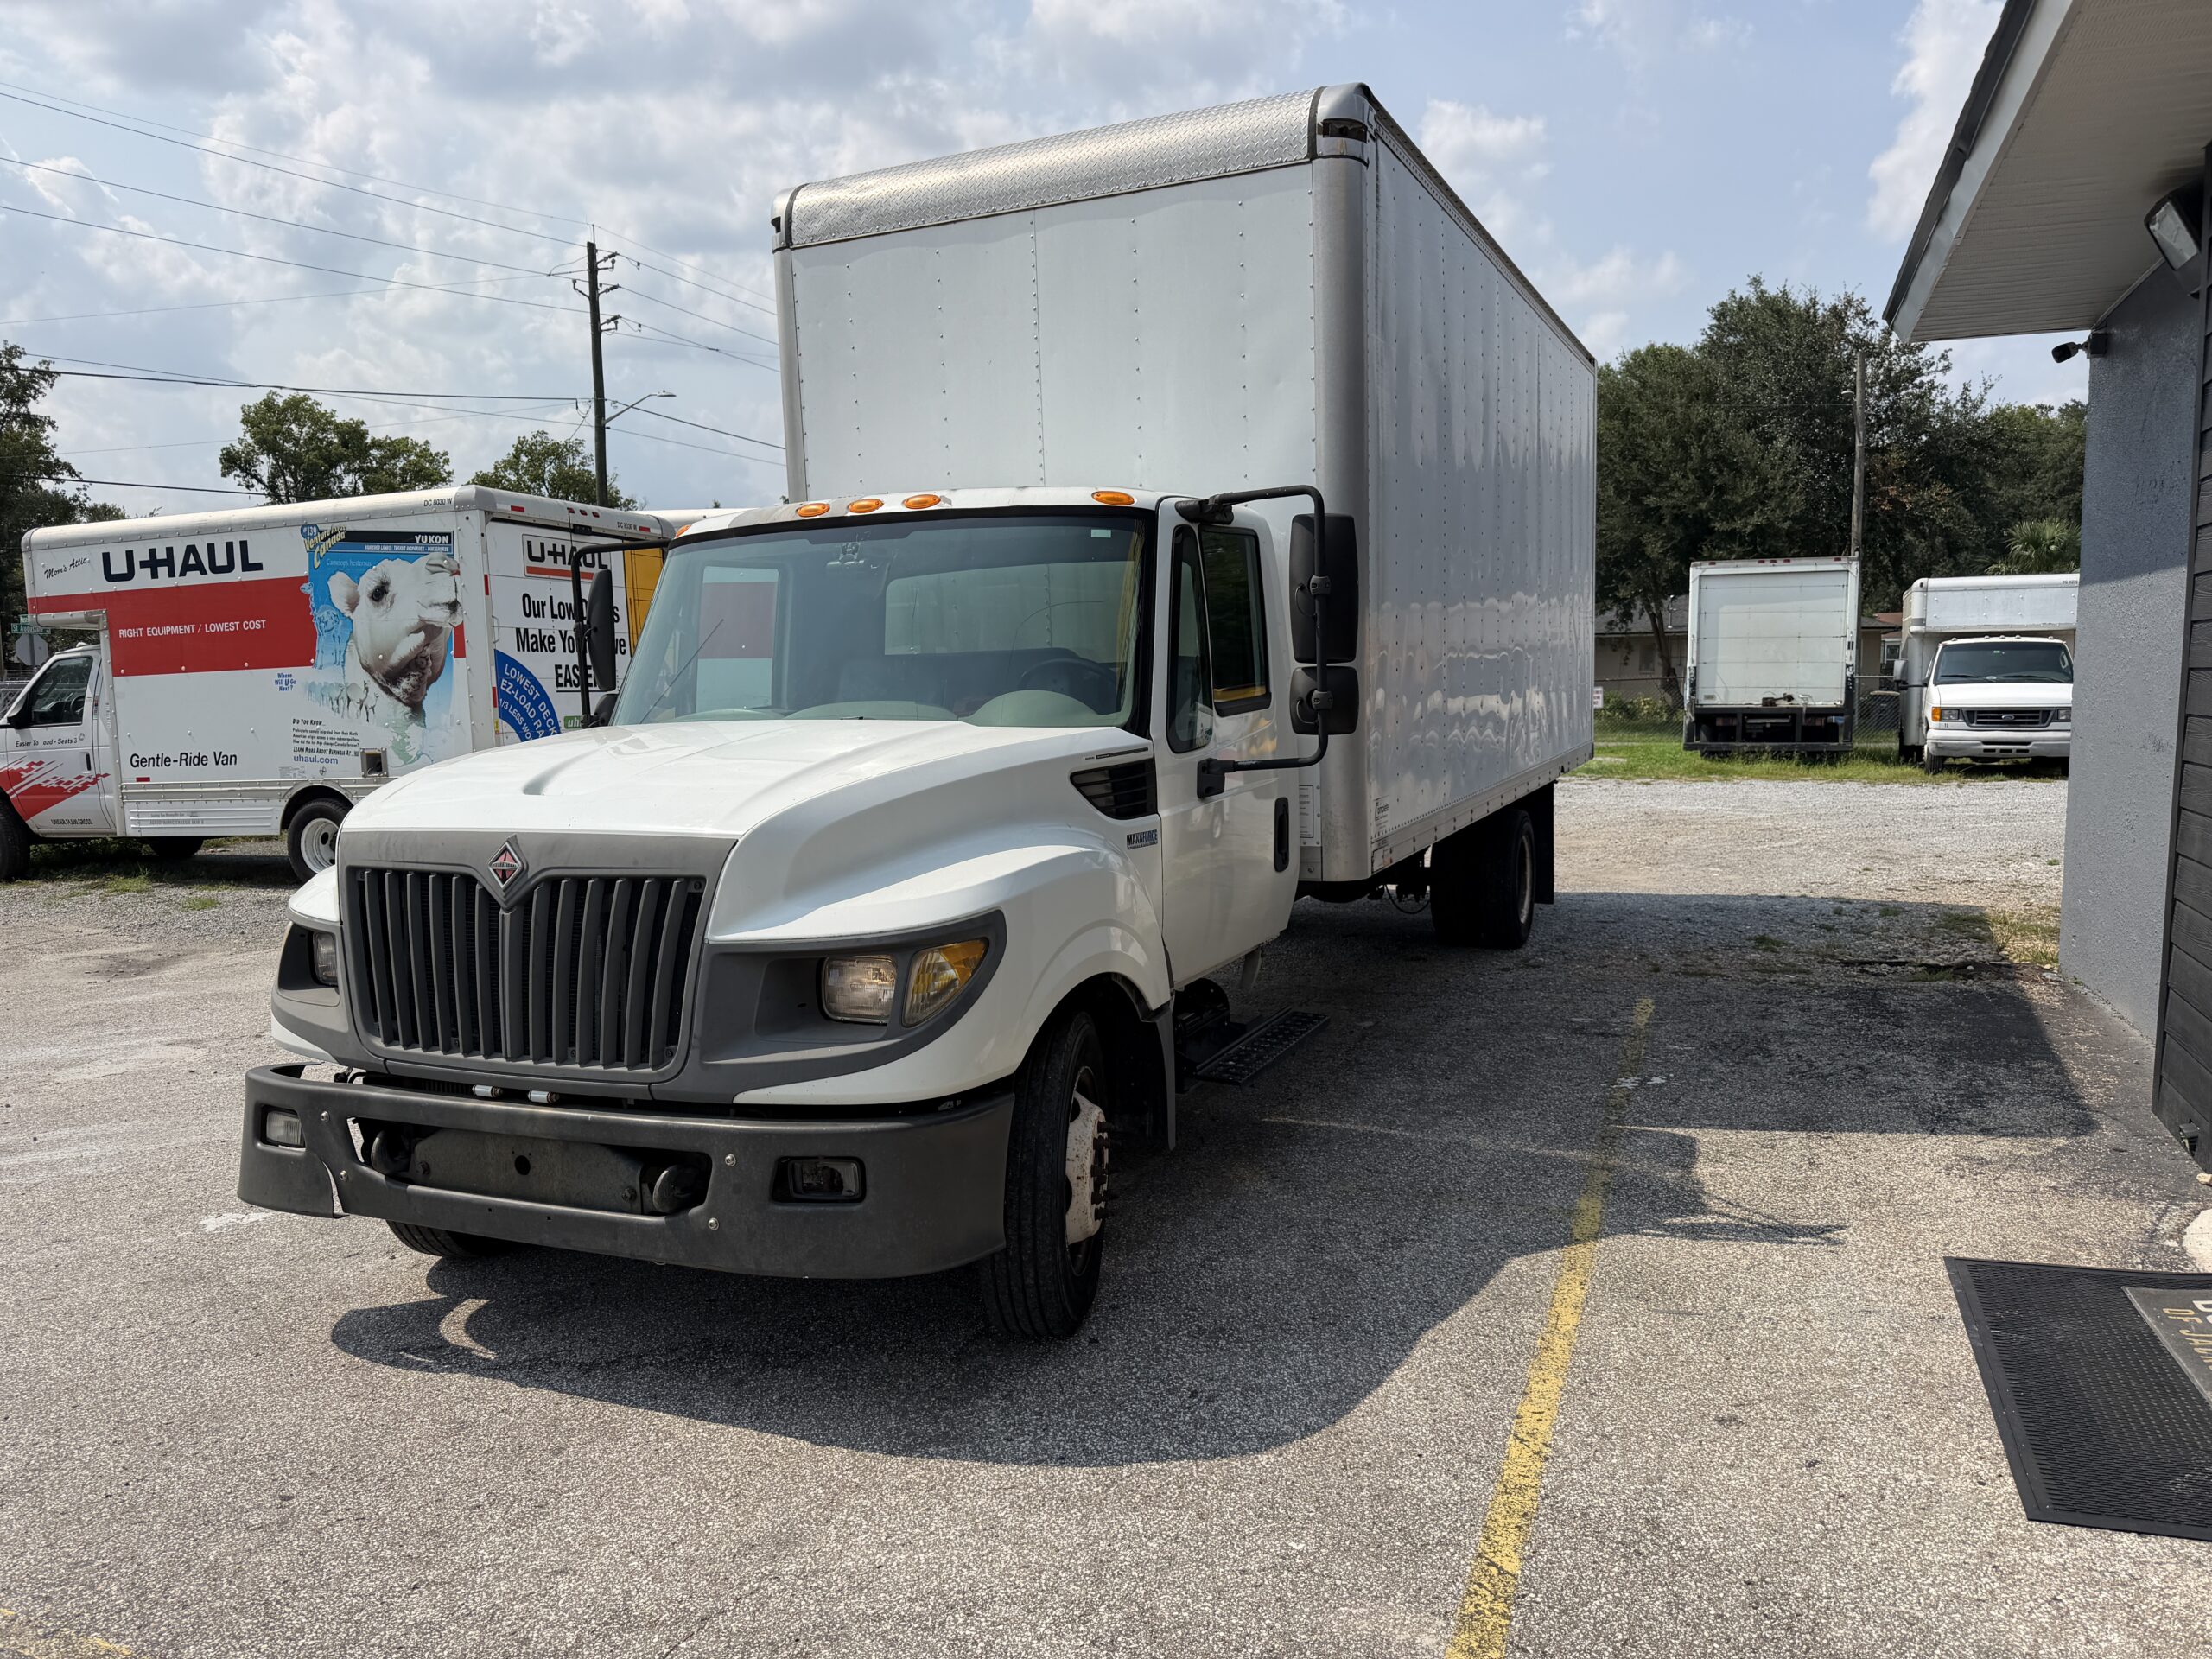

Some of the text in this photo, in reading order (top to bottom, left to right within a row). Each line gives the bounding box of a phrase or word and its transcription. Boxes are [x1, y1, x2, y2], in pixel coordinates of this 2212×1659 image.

[303, 530, 331, 552] Venture
[314, 531, 346, 569] Canada
[415, 535, 448, 544] YUKON
[44, 556, 87, 580] Mom's Attic
[102, 540, 264, 583] U-HAUL
[522, 593, 546, 618] Our
[550, 595, 575, 620] Low
[118, 628, 143, 639] RIGHT
[146, 624, 195, 637] EQUIPMENT
[205, 620, 240, 633] LOWEST
[243, 619, 267, 631] COST
[516, 627, 556, 653] Make
[555, 664, 598, 689] EASE
[500, 678, 537, 719] EZ-LOAD
[505, 664, 558, 735] LOWEST DECK
[499, 698, 510, 710] 1/3
[508, 704, 524, 725] LESS
[130, 751, 238, 767] Gentle-Ride Van
[293, 754, 339, 764] uhaul.com
[2163, 1308, 2203, 1324] OF
